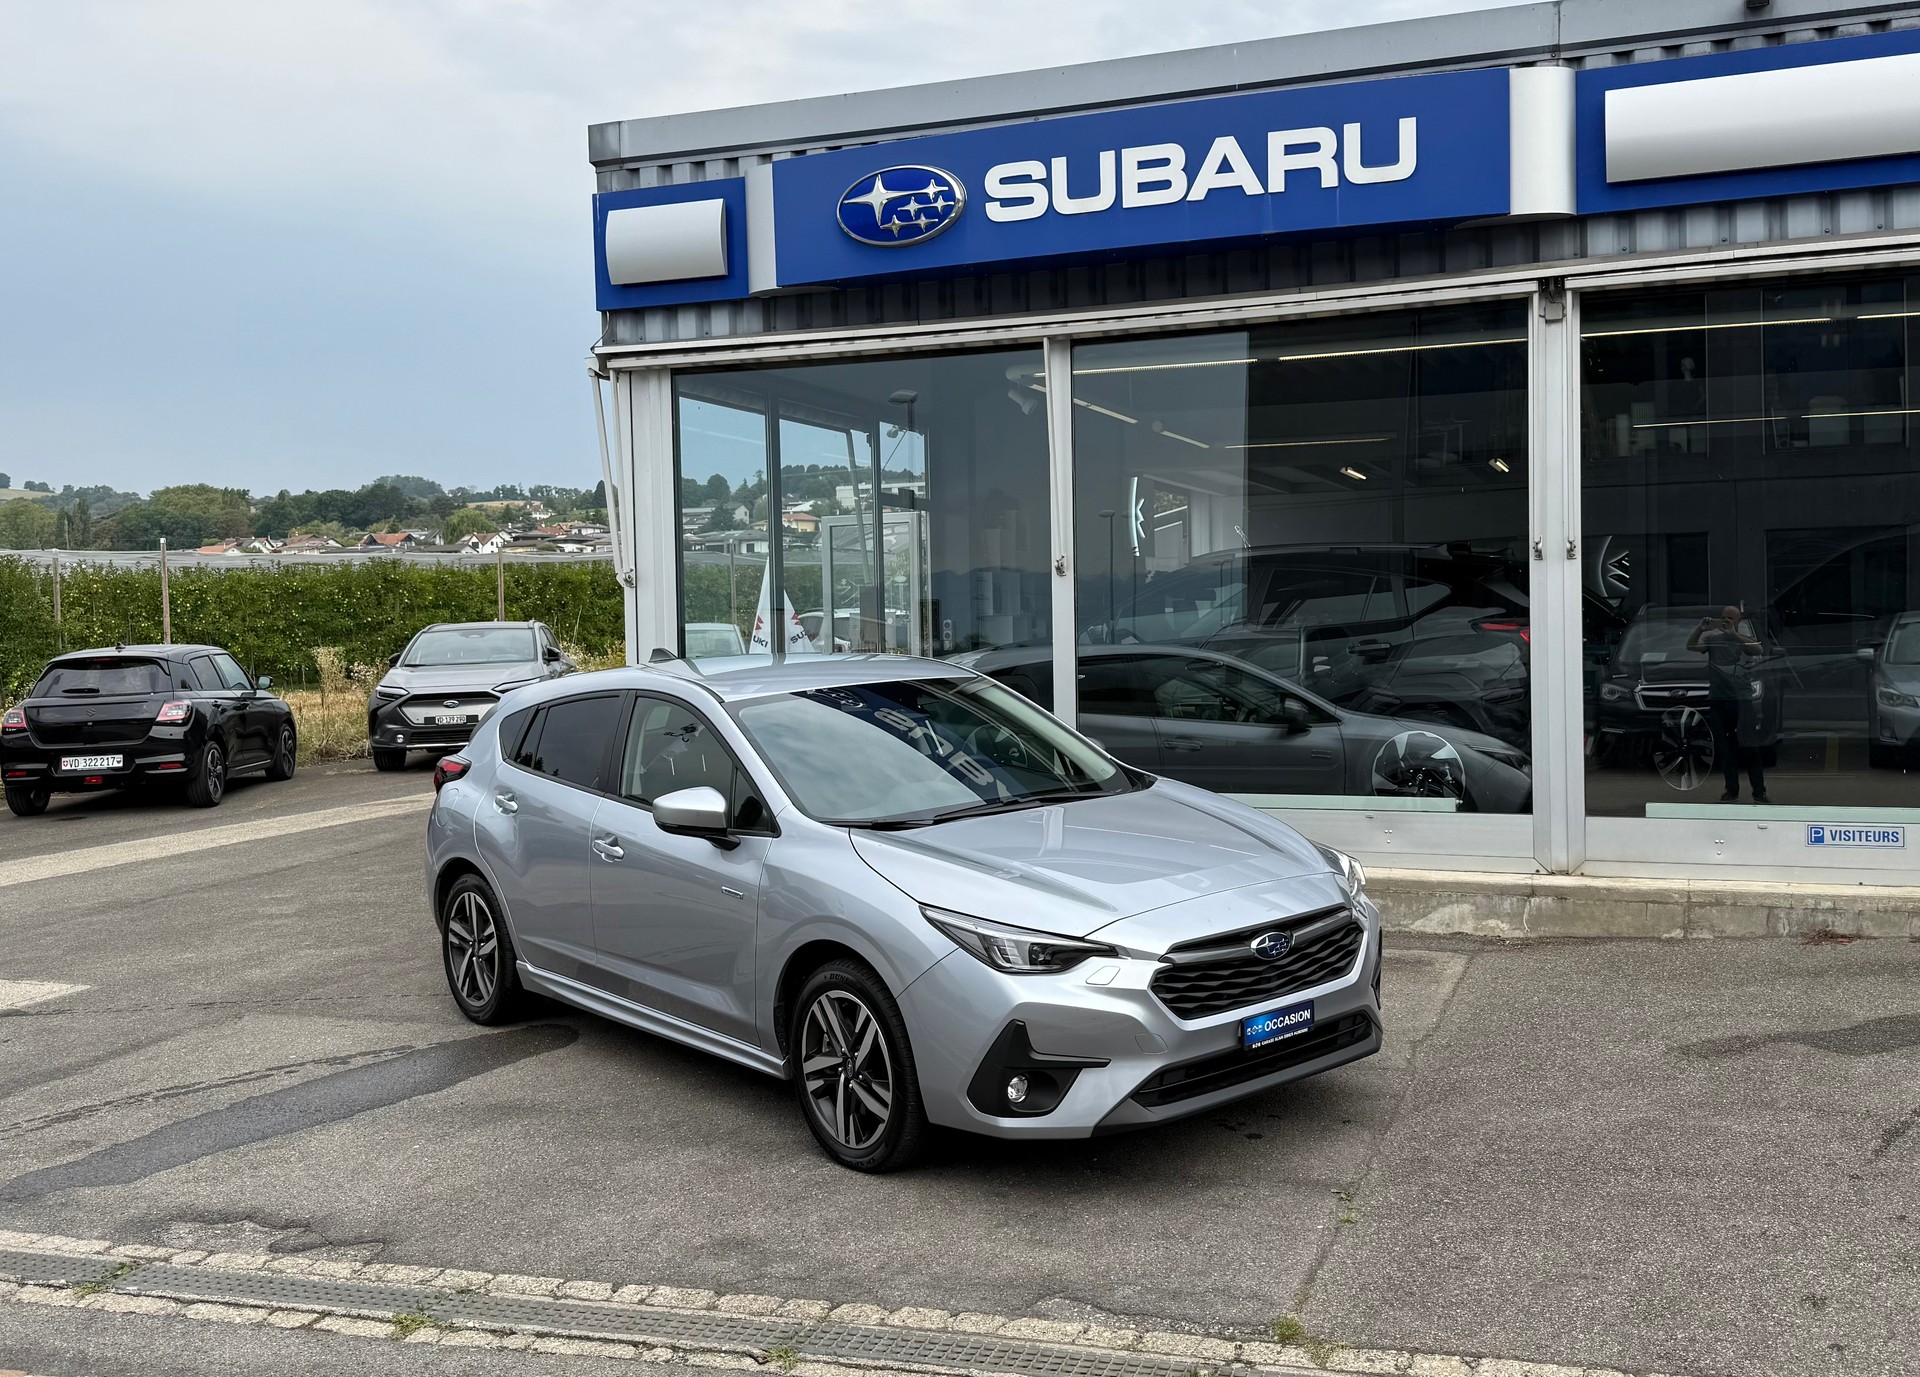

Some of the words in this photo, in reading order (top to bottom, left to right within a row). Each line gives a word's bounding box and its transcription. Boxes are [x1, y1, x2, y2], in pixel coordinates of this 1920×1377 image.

[985, 117, 1417, 223] SUBARU
[69, 759, 80, 768] VD
[83, 756, 116, 768] 322217
[1829, 830, 1900, 842] VISITEURS
[1264, 1008, 1311, 1032] OCCASION
